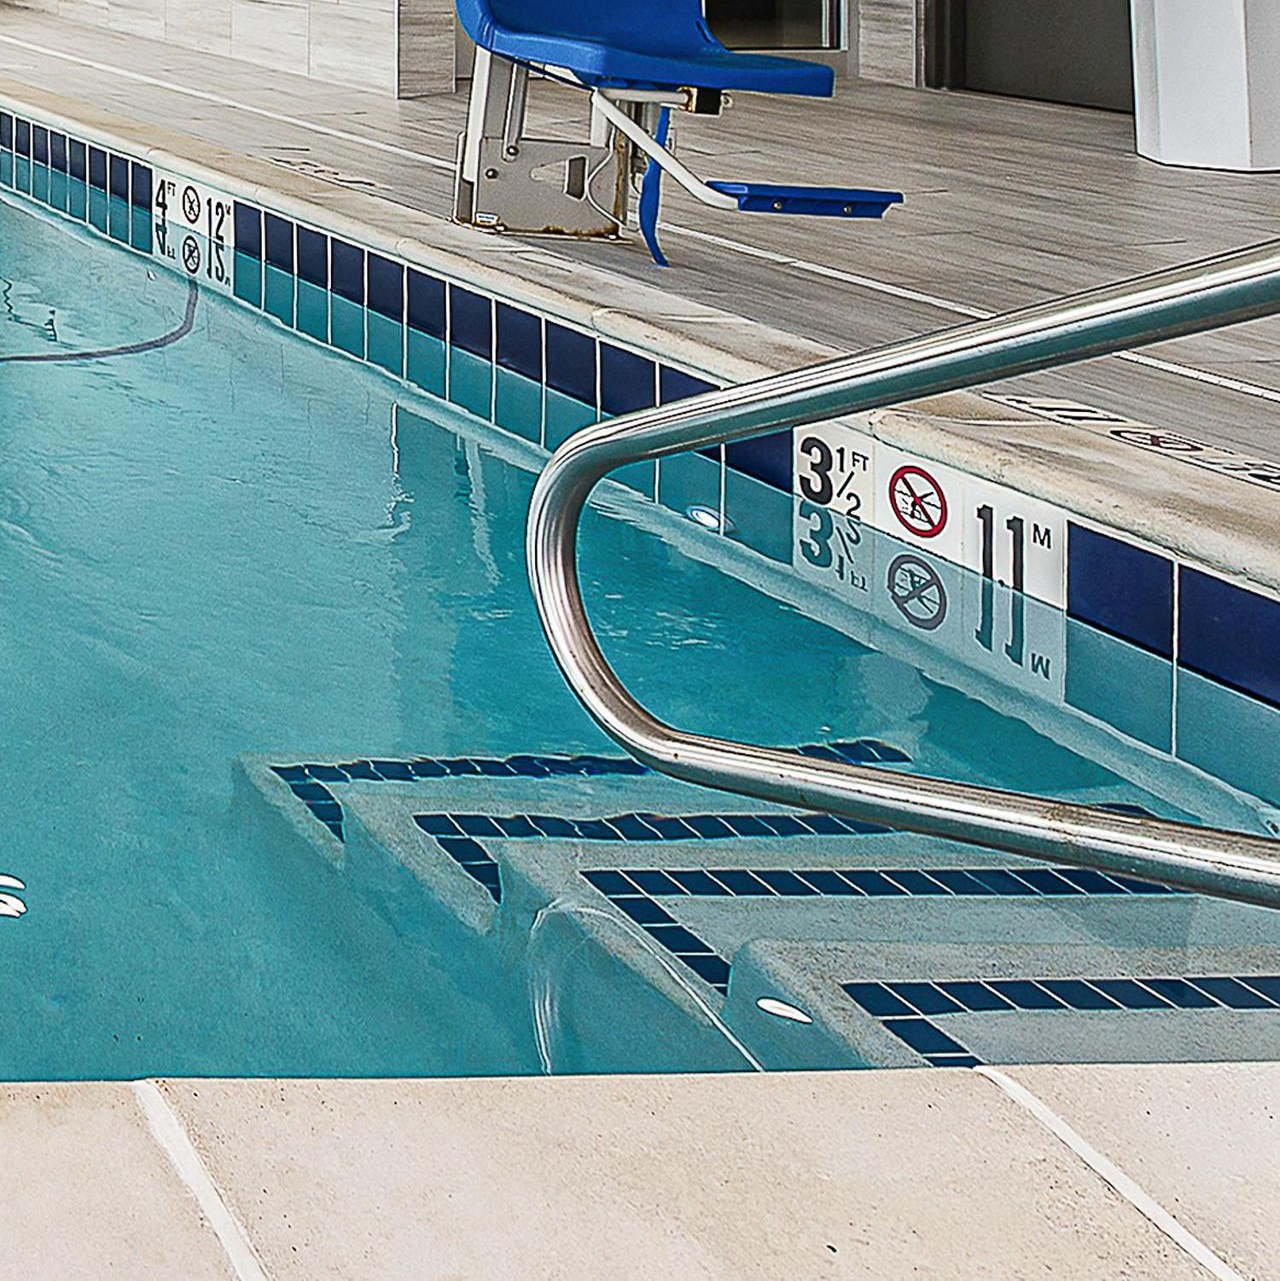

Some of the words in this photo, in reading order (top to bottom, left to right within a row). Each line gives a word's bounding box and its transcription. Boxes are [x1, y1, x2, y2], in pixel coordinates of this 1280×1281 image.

[156, 179, 168, 218] 4
[799, 436, 833, 506] 3
[851, 451, 870, 472] FT
[1032, 523, 1052, 550] M
